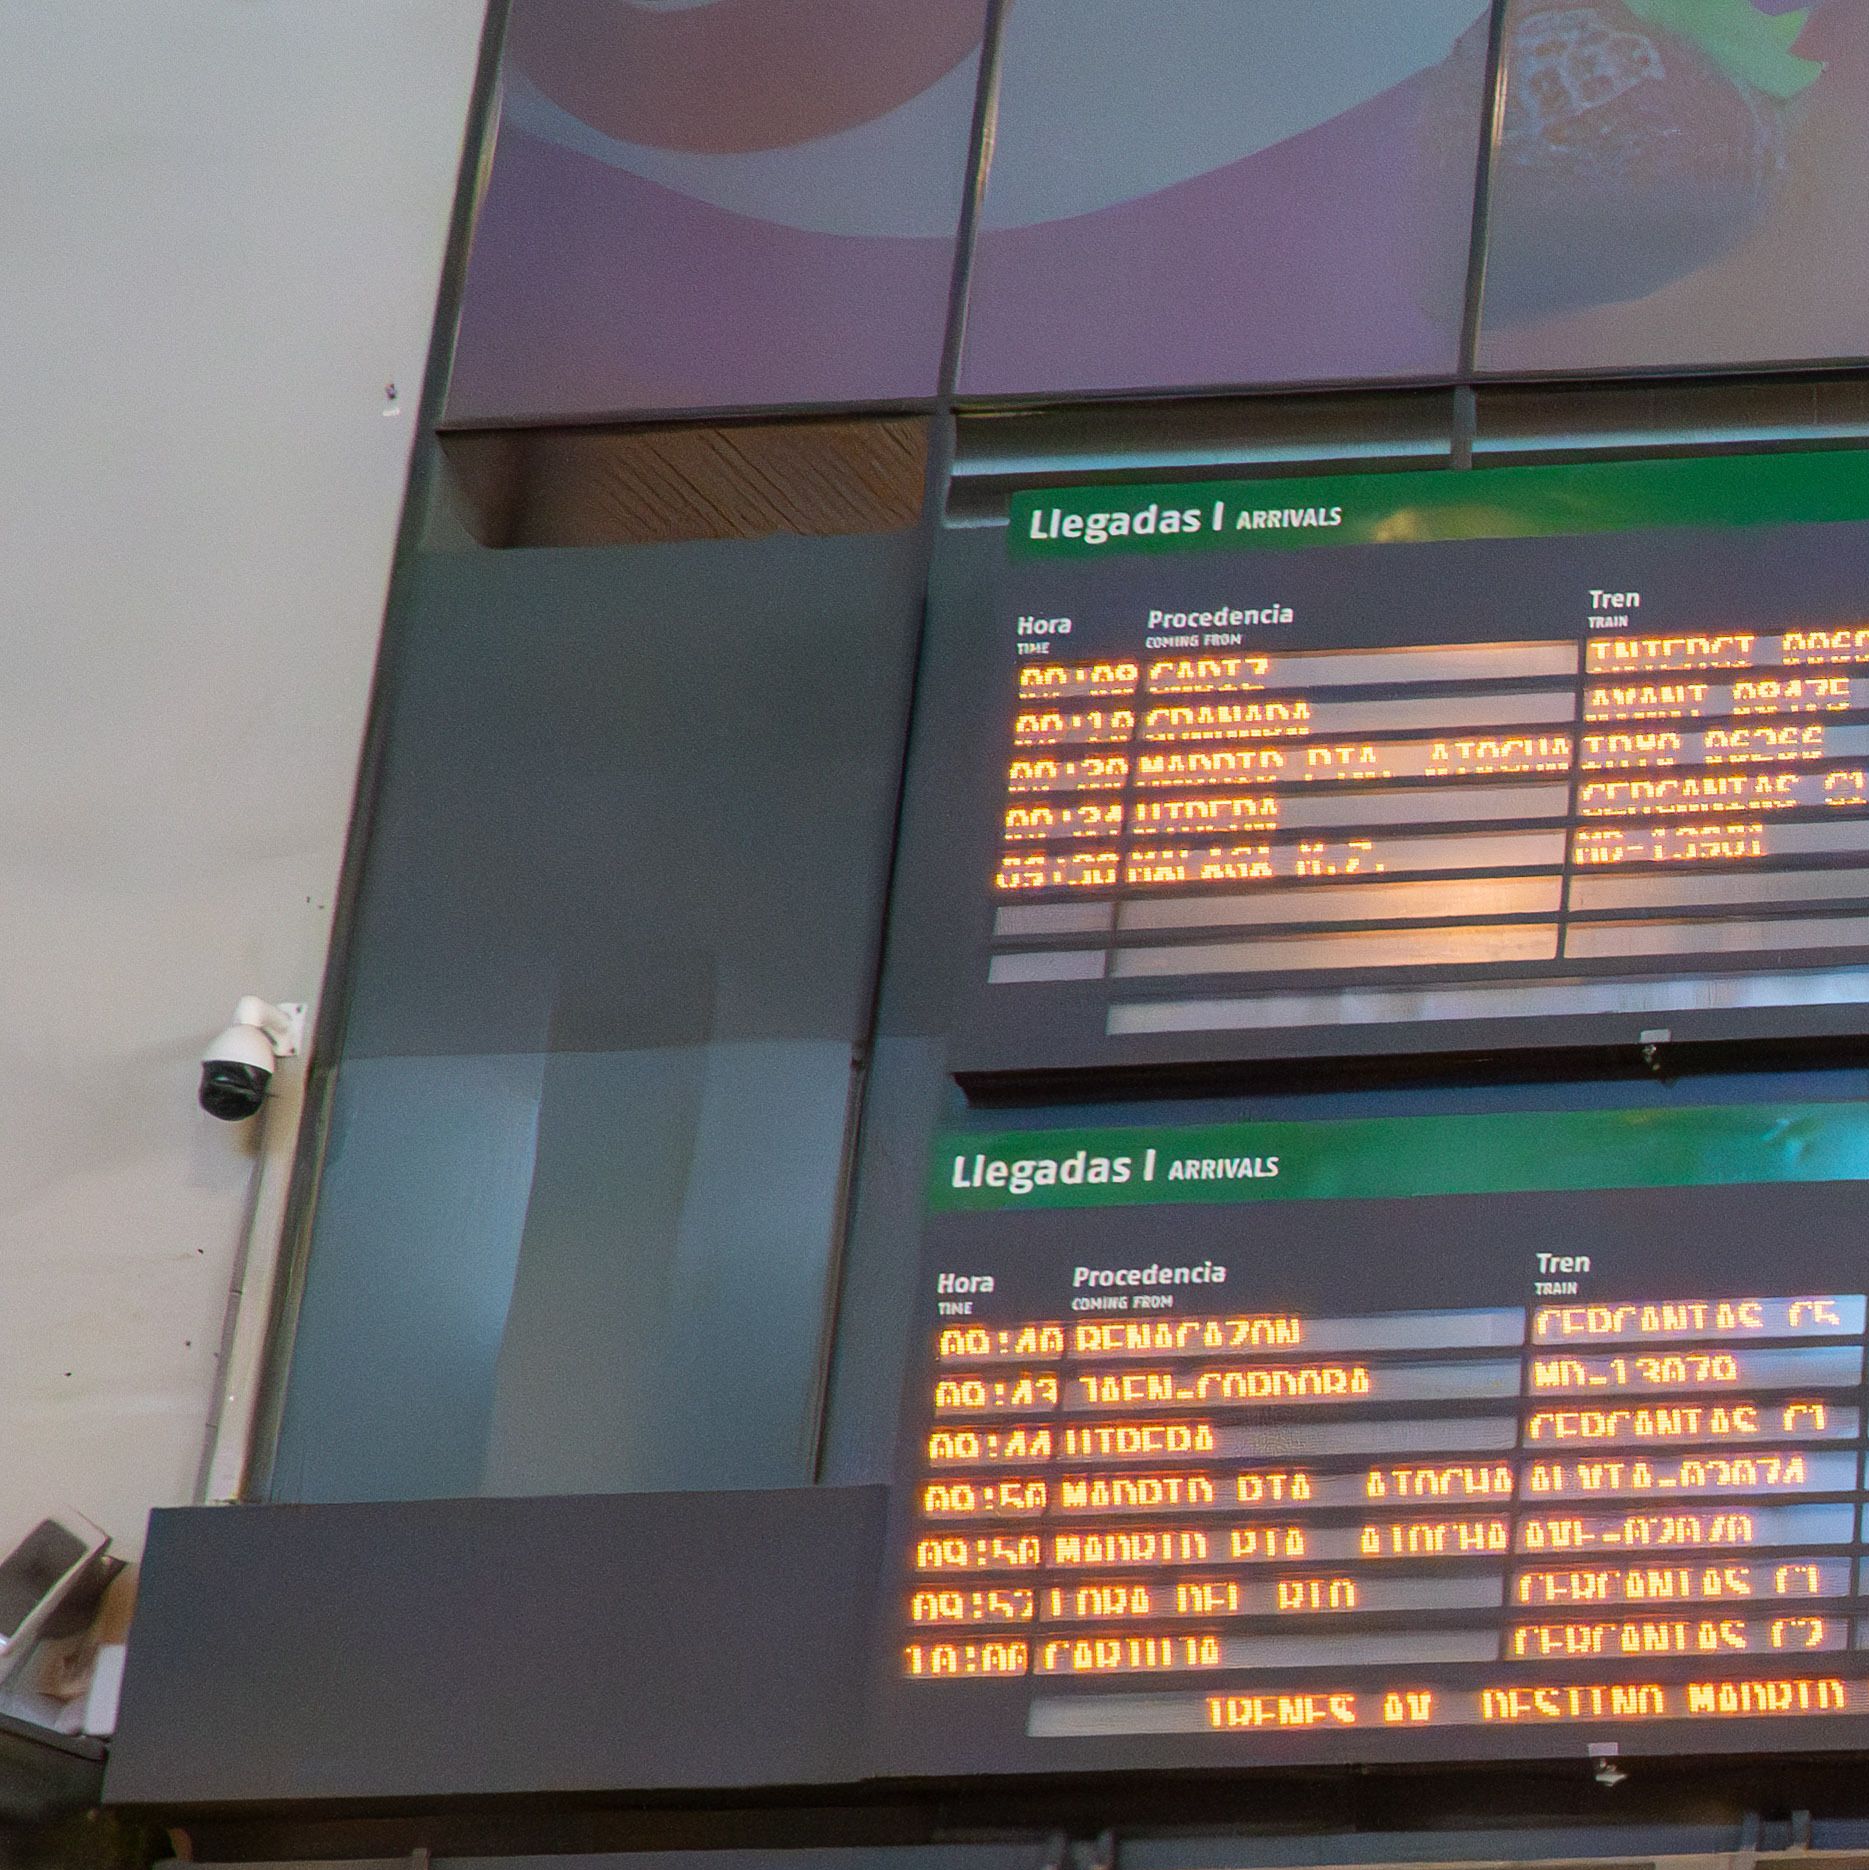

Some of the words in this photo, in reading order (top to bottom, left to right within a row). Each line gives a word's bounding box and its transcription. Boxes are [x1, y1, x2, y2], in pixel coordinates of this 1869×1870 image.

[1030, 502, 1201, 544] Llegadas
[1236, 506, 1342, 529] ARRIVALS
[1589, 588, 1640, 609] Tren
[1017, 616, 1073, 635] Hora
[1148, 604, 1294, 629] Procedencia
[1588, 614, 1629, 628] TRAIN
[1017, 641, 1050, 655] TIME
[952, 1150, 1131, 1194] Llegadas
[1169, 1155, 1279, 1180] ARRIVALS
[1073, 1261, 1226, 1287] Procedencia
[1536, 1253, 1590, 1274] Tren
[937, 1273, 995, 1294] Hora
[1535, 1282, 1577, 1295] TRAIN
